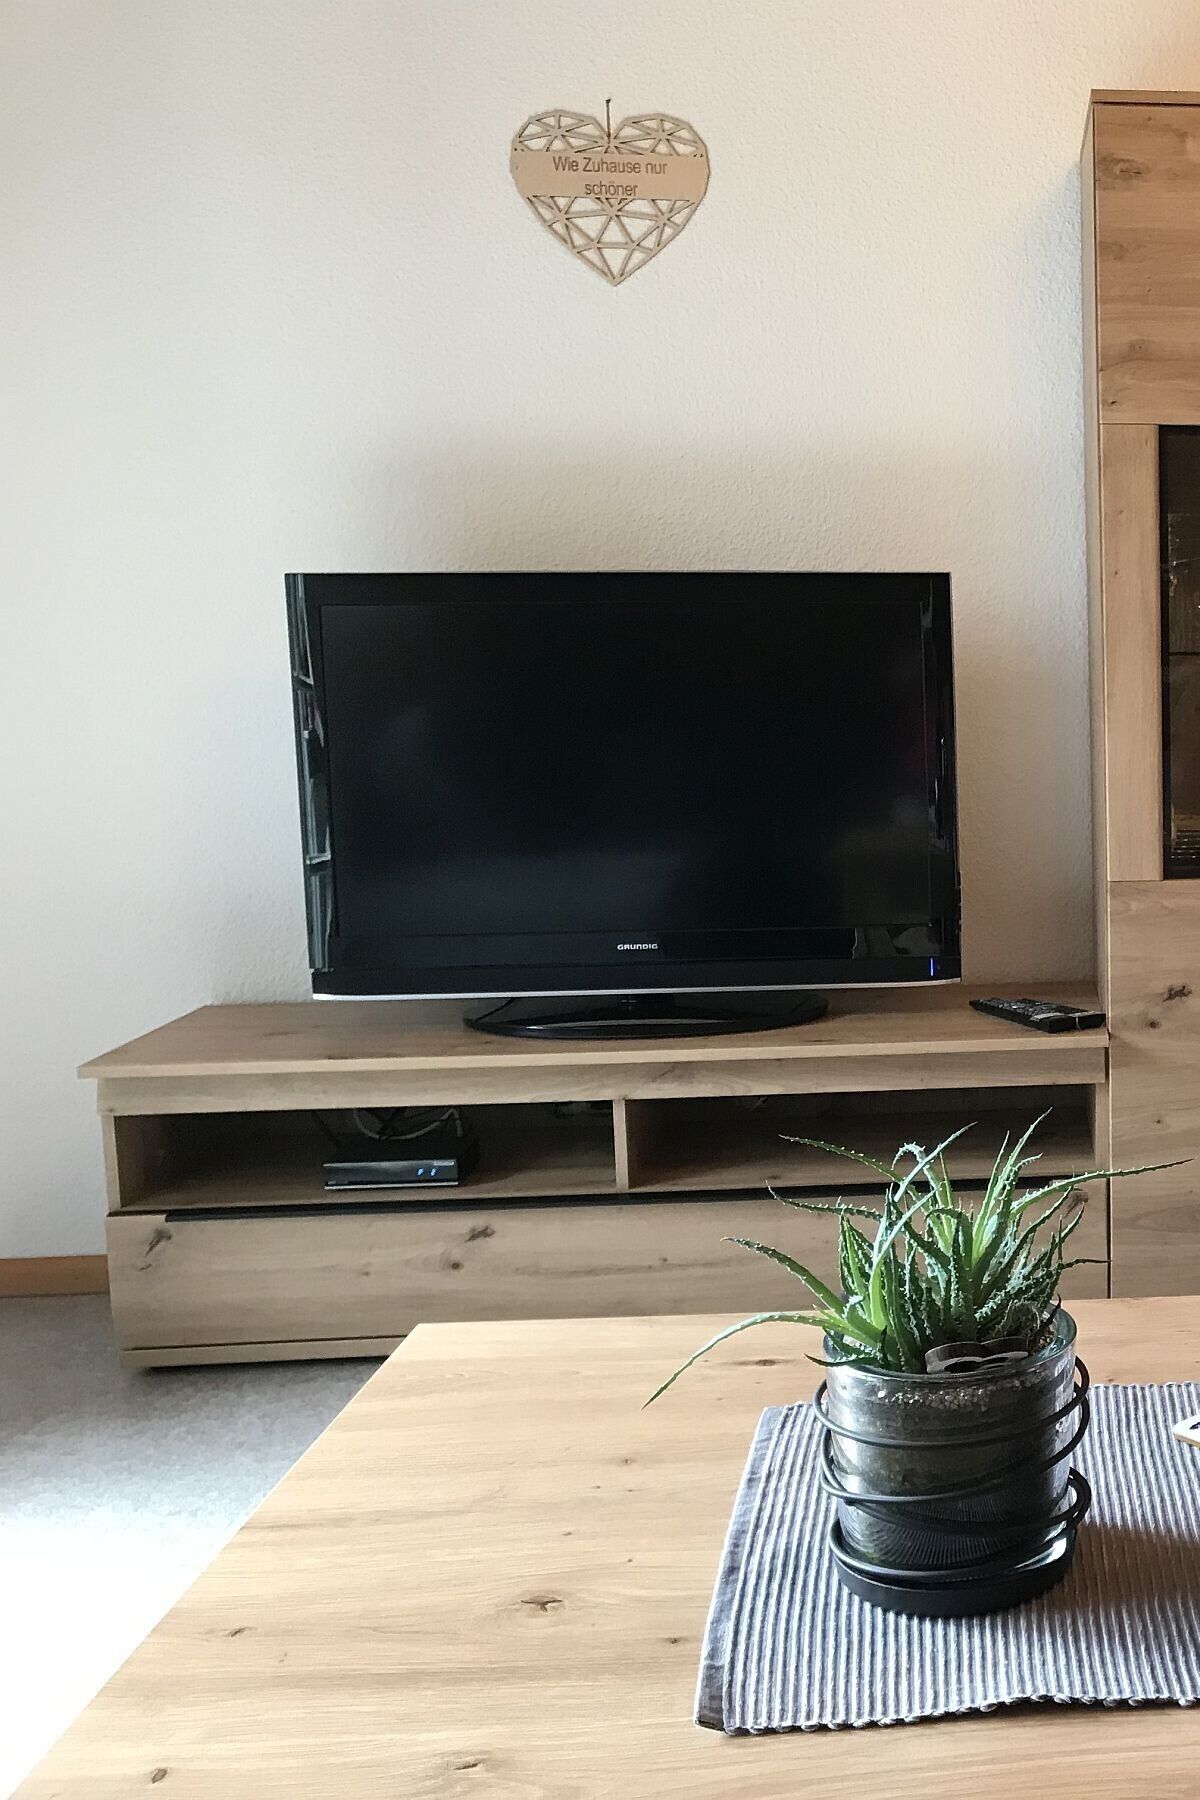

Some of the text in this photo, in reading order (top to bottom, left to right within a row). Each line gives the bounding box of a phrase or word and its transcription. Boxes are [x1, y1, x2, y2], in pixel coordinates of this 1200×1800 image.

[552, 156, 668, 174] Wie Zuhause nur
[584, 181, 638, 196] schöner
[617, 943, 659, 951] GRUNDIG
